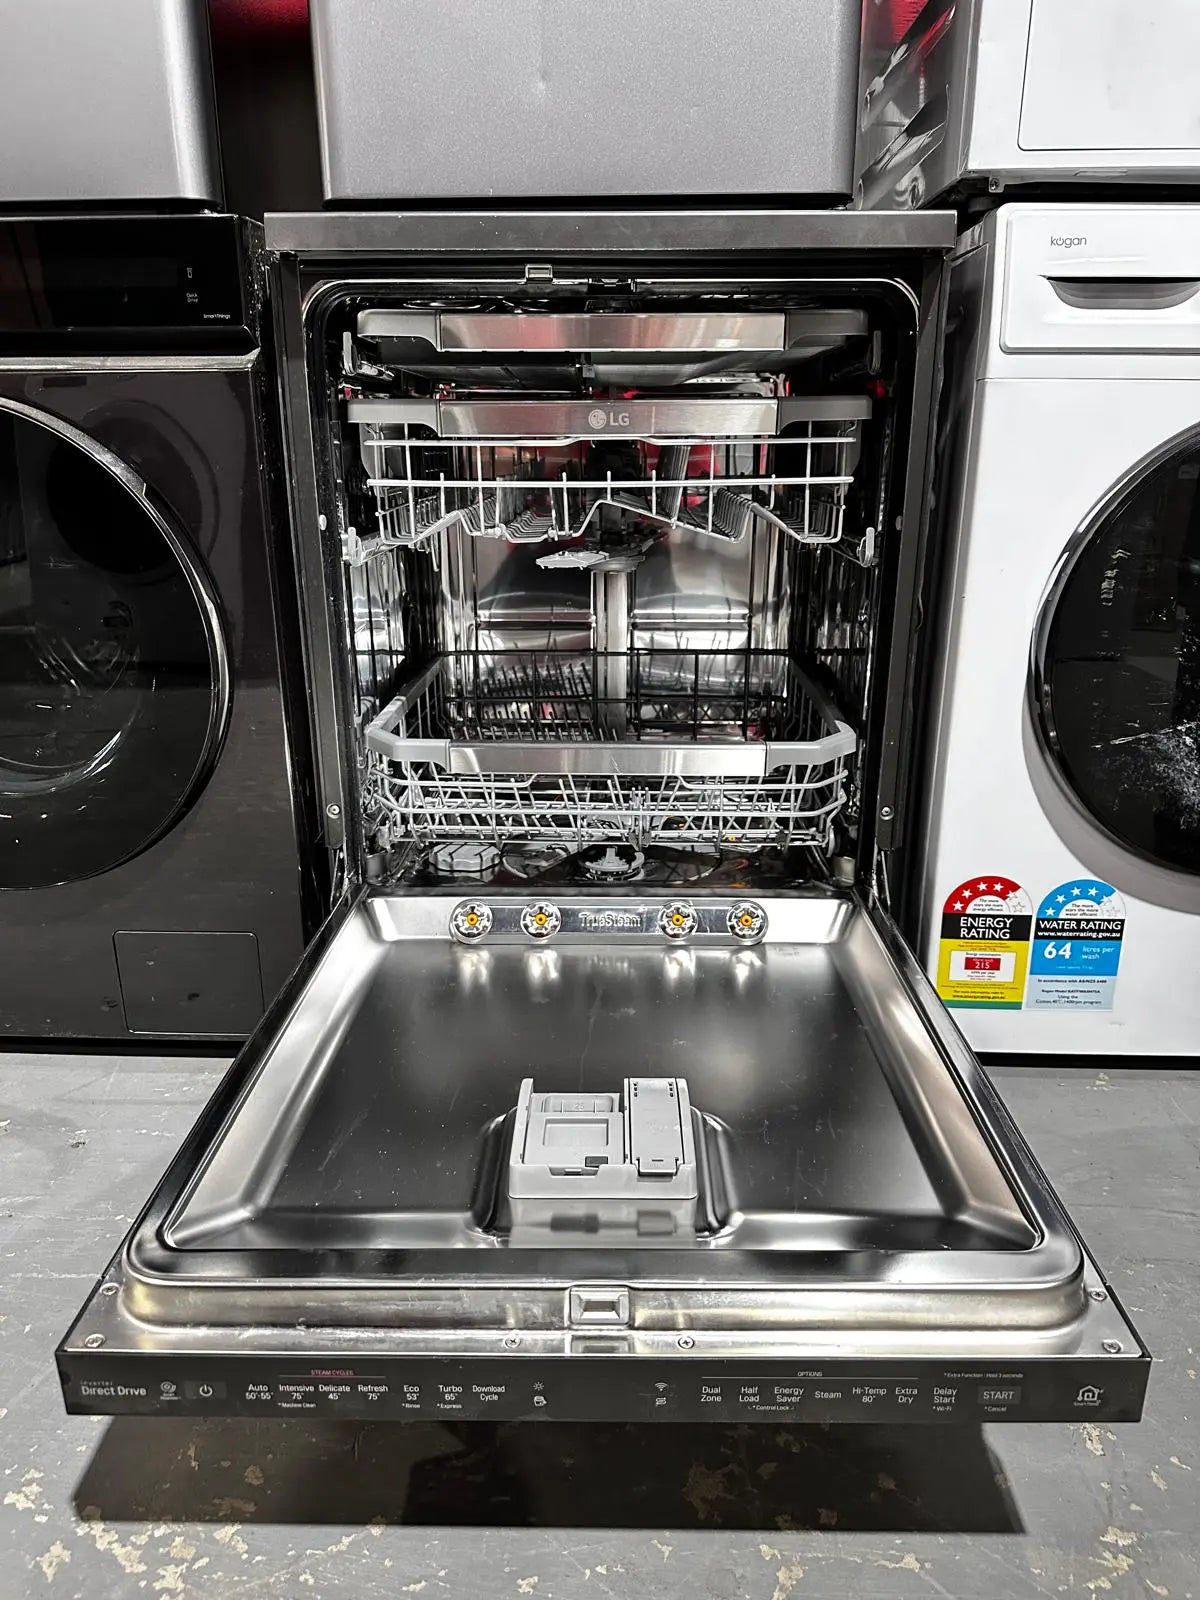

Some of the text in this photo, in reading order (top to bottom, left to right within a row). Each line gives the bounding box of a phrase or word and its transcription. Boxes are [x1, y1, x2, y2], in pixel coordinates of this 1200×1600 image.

[1050, 236, 1087, 248] kogan
[609, 412, 630, 426] LG
[578, 911, 642, 927] TrueSteam
[960, 916, 1014, 928] ENERGY
[1039, 920, 1122, 930] WATER RATING
[960, 928, 1011, 940] RATING
[1044, 941, 1072, 960] 64
[974, 962, 990, 970] 215
[81, 1386, 146, 1396] Direct Drive
[248, 1384, 268, 1392] Auto
[318, 1384, 350, 1392] Delicate
[358, 1384, 388, 1392] Refresh
[438, 1384, 463, 1392] Turbo
[472, 1384, 506, 1393] Download
[774, 1386, 804, 1395] Energy
[852, 1387, 887, 1396] Hi-Temp
[933, 1387, 958, 1395] Delay
[480, 1393, 499, 1402] Cycle
[814, 1391, 842, 1399] Steam
[983, 1391, 1015, 1400] START
[898, 1396, 914, 1404] Dry
